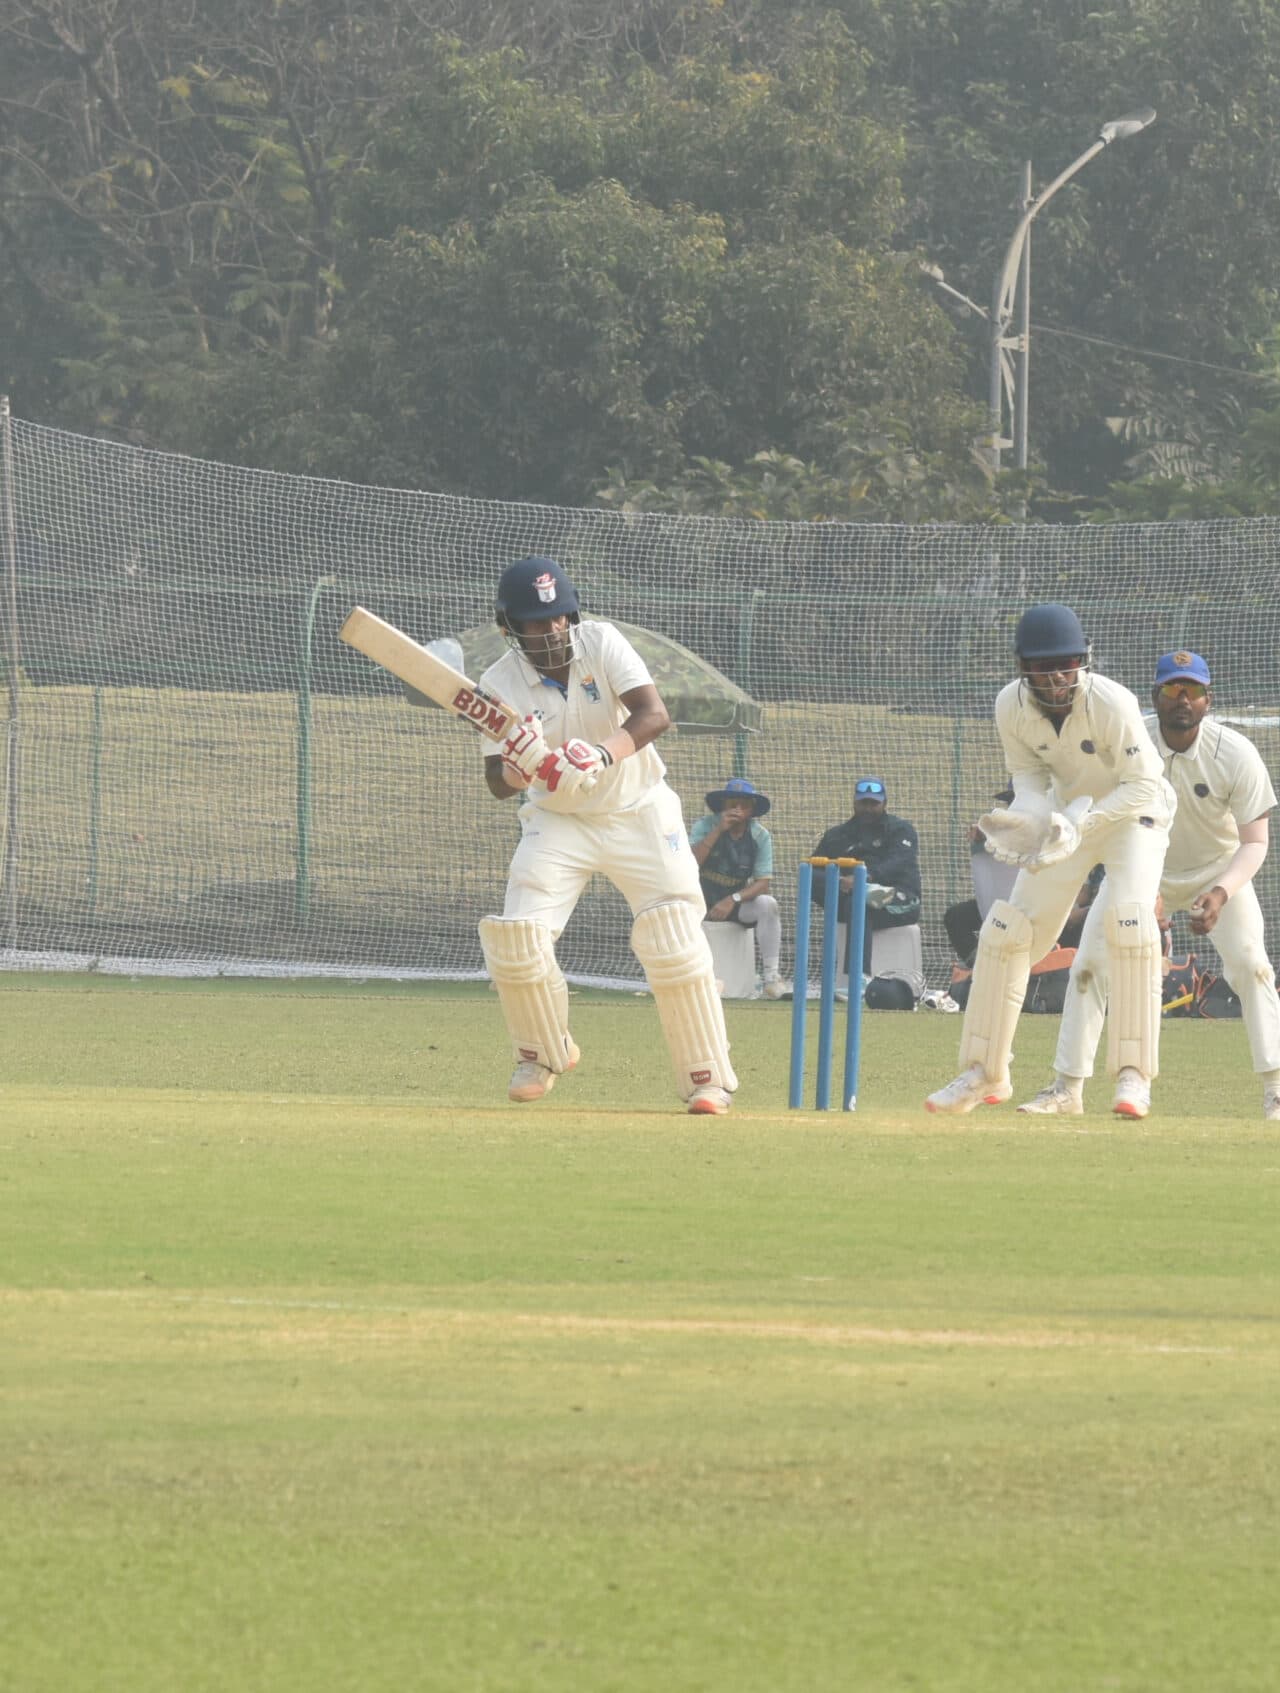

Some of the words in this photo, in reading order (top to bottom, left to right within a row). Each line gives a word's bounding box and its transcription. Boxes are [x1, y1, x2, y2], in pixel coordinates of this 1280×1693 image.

[452, 687, 509, 734] BDM
[991, 918, 1008, 931] TON
[1119, 919, 1138, 927] TON
